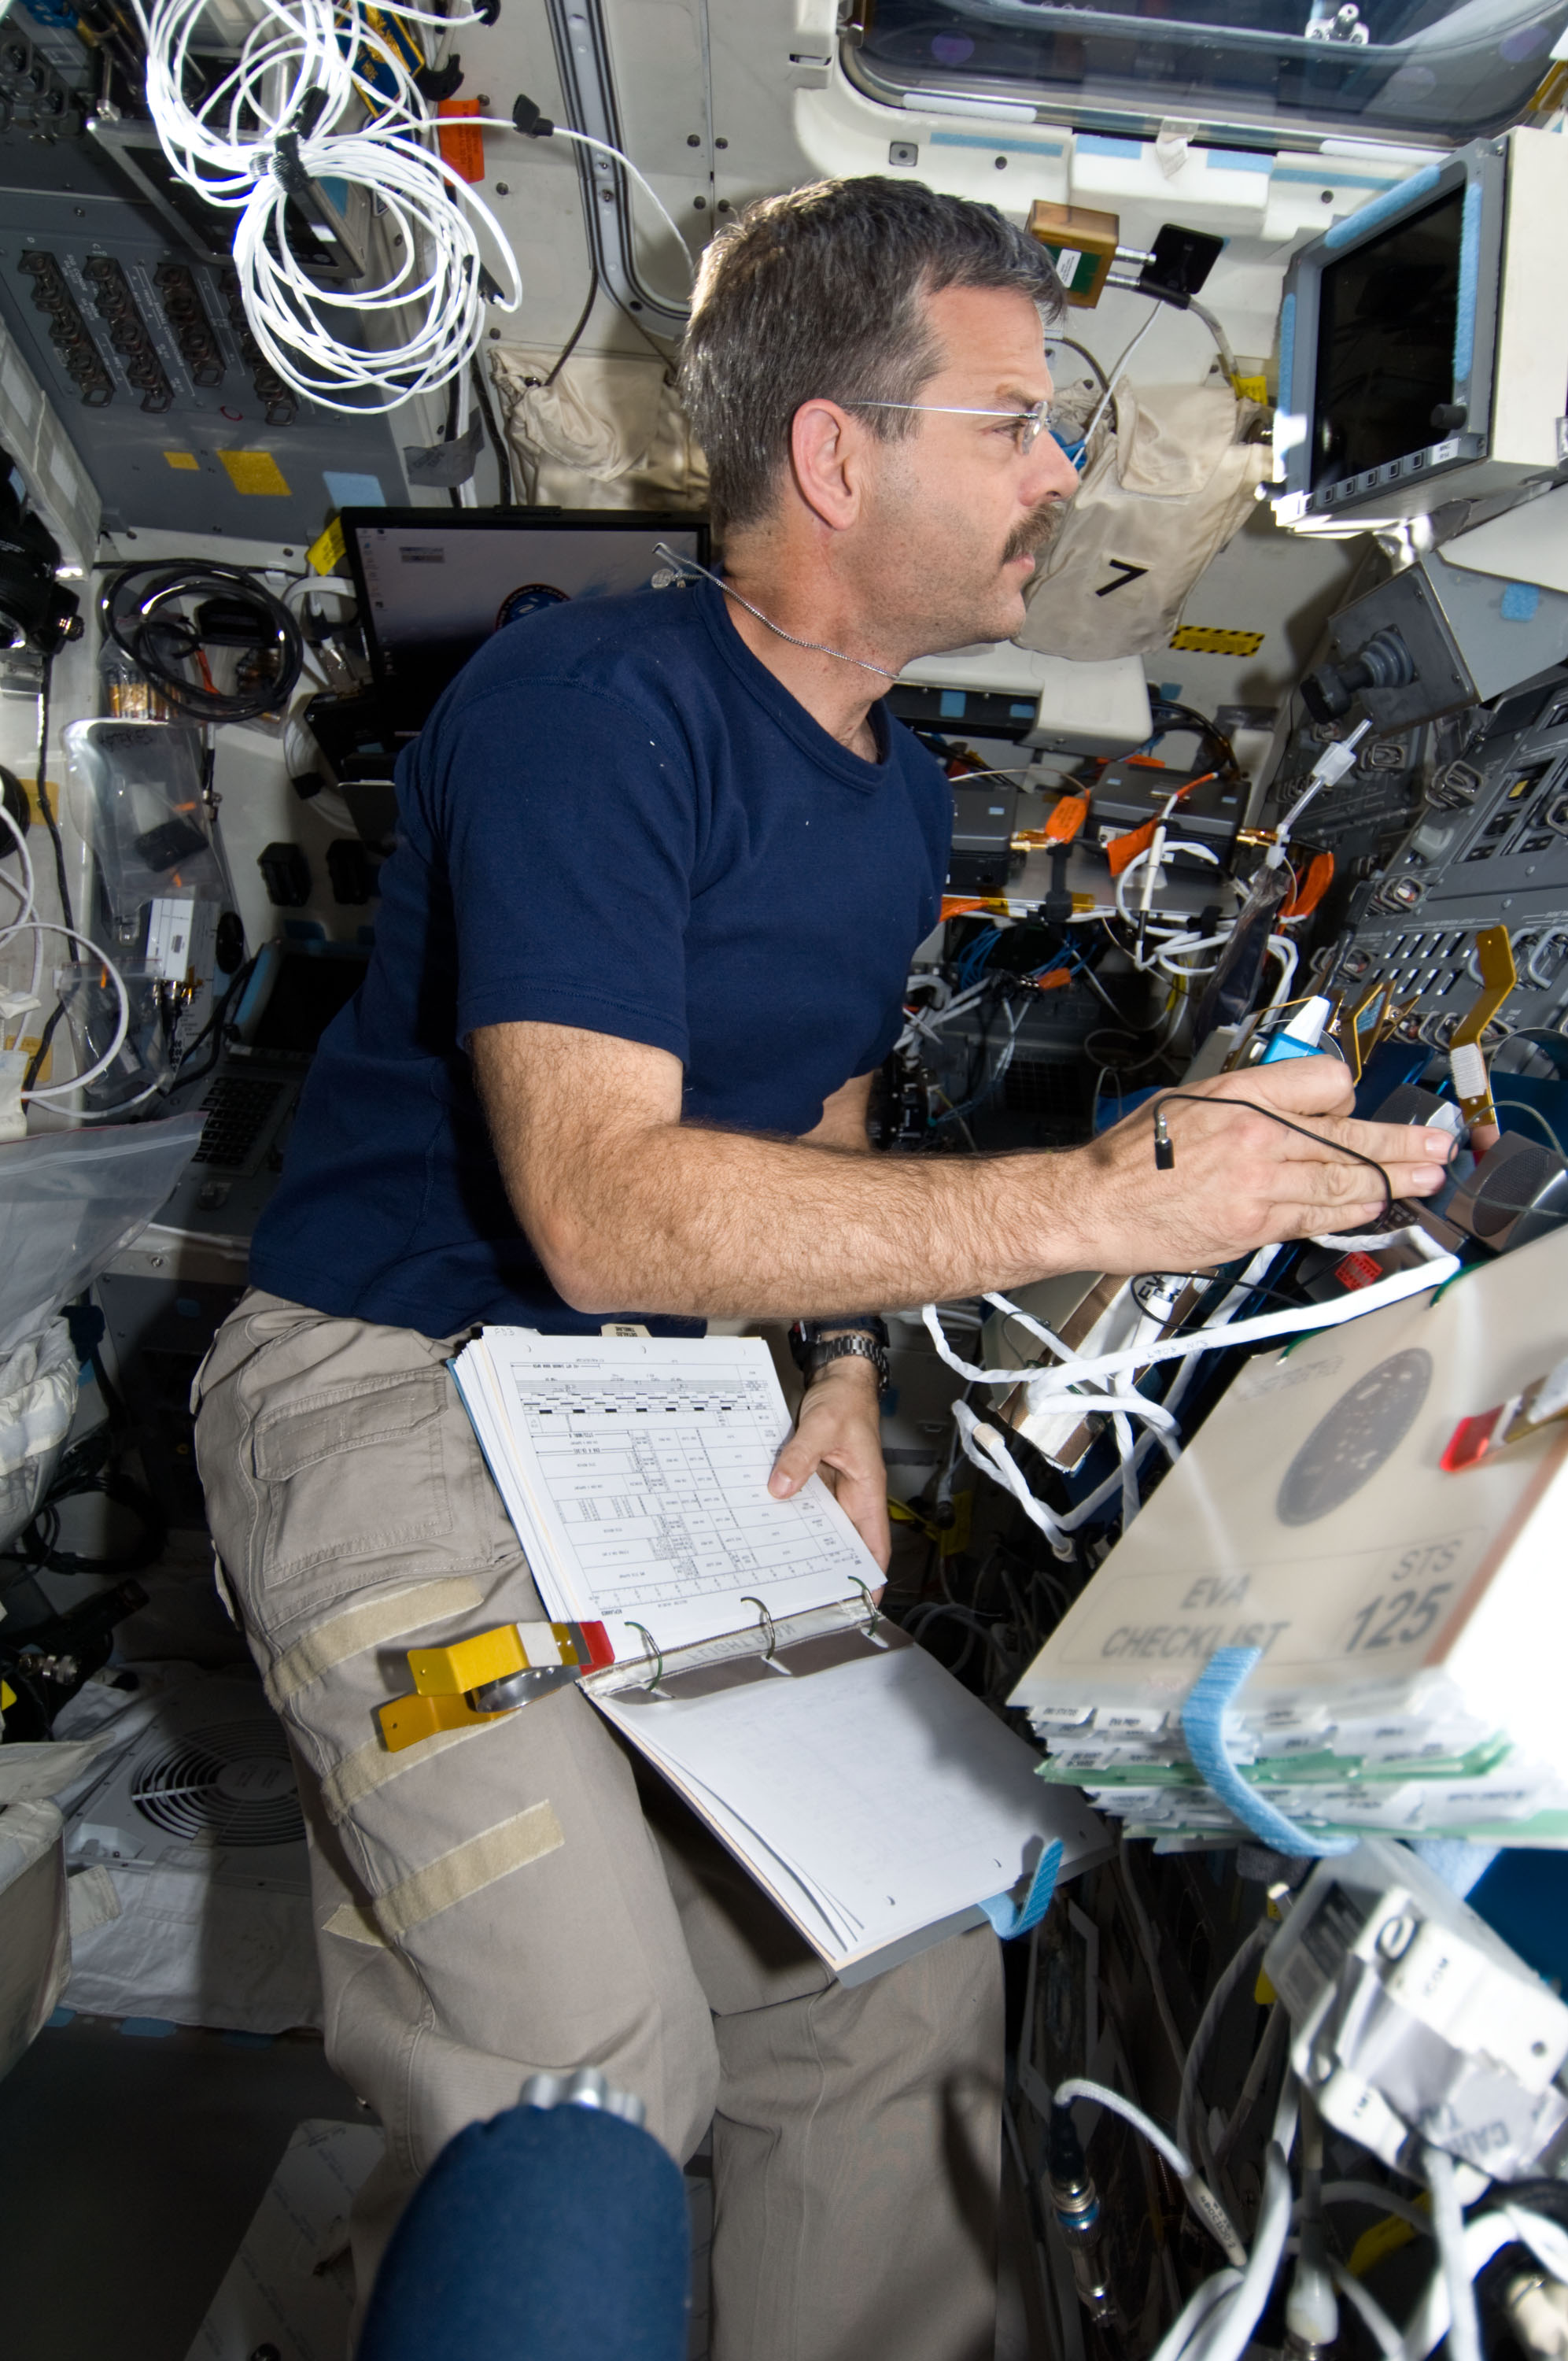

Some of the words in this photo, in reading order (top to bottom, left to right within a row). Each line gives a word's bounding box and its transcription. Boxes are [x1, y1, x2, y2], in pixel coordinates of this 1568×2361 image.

[1392, 1540, 1463, 1582] STS
[1180, 1574, 1253, 1610] EVA
[1344, 1583, 1453, 1653] 125
[1101, 1622, 1292, 1661] CHECKLIST
